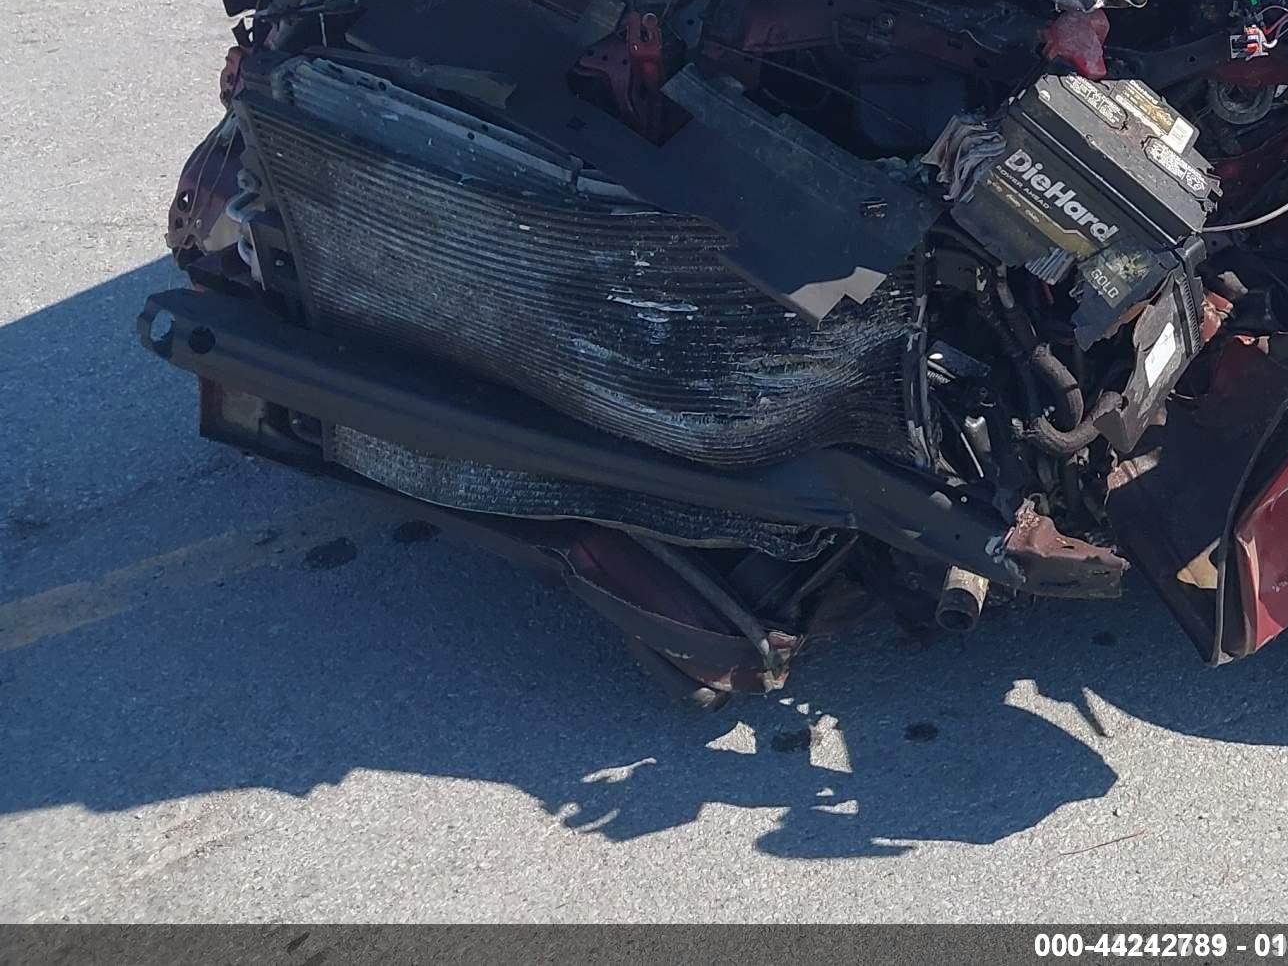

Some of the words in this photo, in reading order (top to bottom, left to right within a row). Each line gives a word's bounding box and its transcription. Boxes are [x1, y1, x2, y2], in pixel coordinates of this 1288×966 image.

[995, 164, 1024, 188] POWER
[1024, 187, 1050, 210] AHEAD
[1004, 148, 1119, 243] DieHard
[1090, 268, 1119, 299] GOLD
